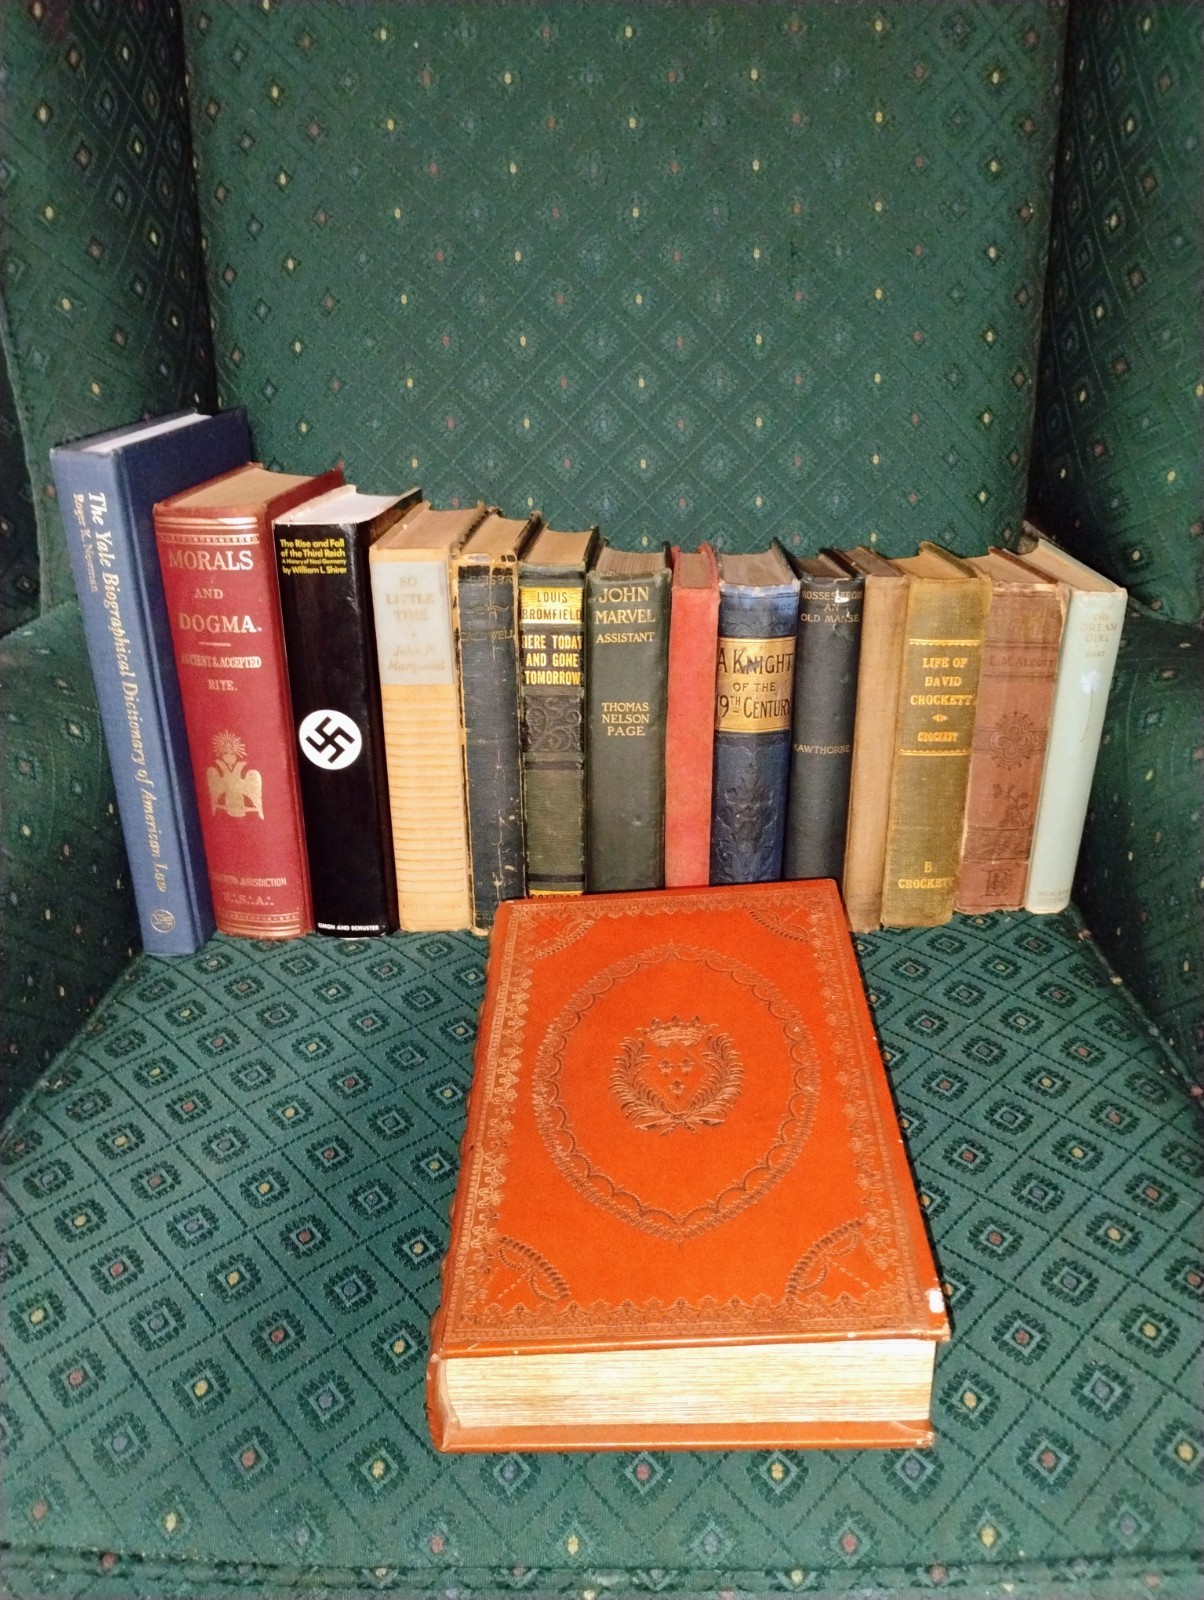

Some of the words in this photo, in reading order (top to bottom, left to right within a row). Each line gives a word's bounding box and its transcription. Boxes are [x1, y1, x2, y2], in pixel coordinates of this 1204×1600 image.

[88, 492, 107, 526] The
[280, 538, 294, 548] The
[295, 539, 311, 548] Rise
[312, 539, 329, 548] and
[330, 538, 345, 548] Fall
[95, 531, 113, 568] Yale
[281, 549, 288, 557] of
[289, 549, 302, 557] the
[303, 549, 323, 557] Third
[324, 548, 346, 558] Reich
[168, 550, 254, 571] MORALS
[282, 566, 291, 575] by
[291, 566, 319, 574] William
[326, 566, 347, 574] Shirer
[194, 588, 224, 600] AND
[537, 591, 568, 603] LOUIS
[598, 586, 649, 603] JOHN
[823, 603, 840, 612] AN
[522, 608, 581, 620] BROMFIELD
[595, 609, 655, 625] MARVEL
[800, 613, 821, 622] OLD
[824, 613, 859, 624] MANSE
[102, 571, 136, 678] Biographical
[179, 613, 262, 634] DOGMA.
[552, 635, 582, 650] TODAY
[596, 631, 656, 644] ASSISTANT
[526, 653, 547, 667] AND
[552, 653, 579, 667] GONE
[717, 648, 727, 673] A
[732, 648, 794, 674] KNIGHT
[922, 657, 950, 669] LIFE
[952, 657, 968, 669] OF
[525, 671, 581, 685] TOMORROW
[924, 676, 963, 687] DAVID
[732, 682, 749, 693] OF
[755, 682, 776, 692] THE
[910, 694, 973, 706] CROCKETT
[601, 702, 650, 712] THOMAS
[743, 697, 791, 719] CENTURY
[122, 681, 146, 766] Dictionary
[601, 714, 650, 724] NELSON
[607, 726, 646, 736] PAGE
[135, 768, 155, 788] of
[140, 787, 162, 858] American
[923, 861, 933, 873] B
[317, 922, 336, 930] SIMON
[350, 924, 380, 932] SCHUSTER
